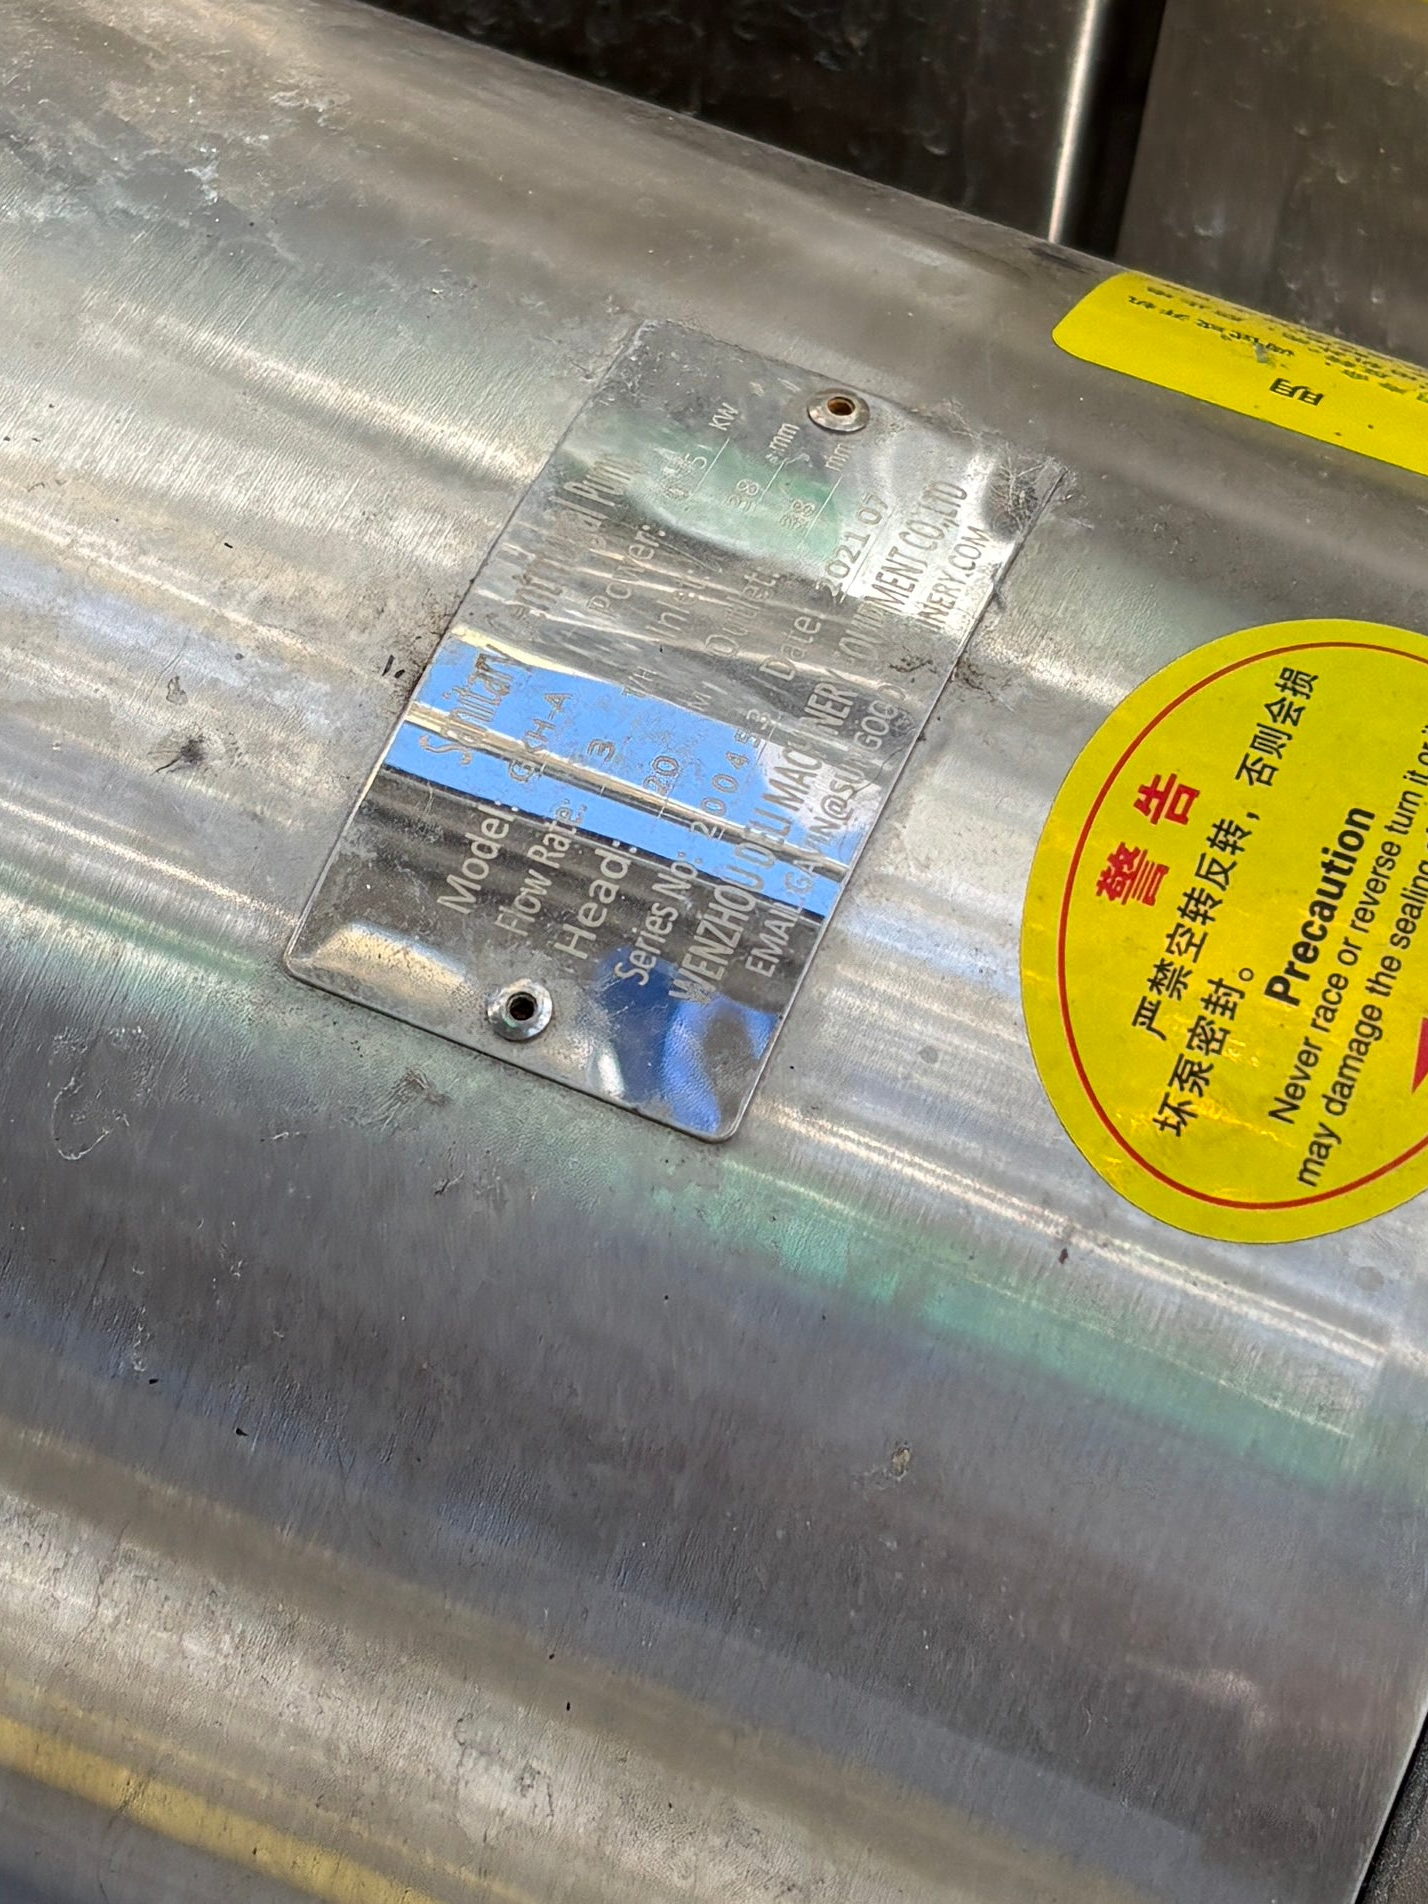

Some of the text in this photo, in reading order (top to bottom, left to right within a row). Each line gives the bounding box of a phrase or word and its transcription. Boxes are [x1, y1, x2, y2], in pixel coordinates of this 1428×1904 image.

[586, 402, 739, 614] Power: KW
[768, 421, 800, 453] mm
[419, 643, 528, 765] Sanitary
[436, 799, 519, 915] Model:
[495, 868, 552, 937] Flow
[586, 738, 616, 763] 3
[552, 839, 638, 960] Head:
[642, 753, 682, 795] 20
[667, 866, 764, 1006] WENZHOU
[762, 668, 859, 811] MACHNERY
[1096, 773, 1200, 907] 警告
[1264, 807, 1376, 1007] Precaution
[614, 901, 680, 986] Series
[1268, 1036, 1322, 1124] Never
[1310, 973, 1349, 1033] race
[1337, 936, 1362, 966] or
[1350, 841, 1402, 933] reverse
[1384, 790, 1423, 835] turn
[1297, 1122, 1342, 1187] may
[1321, 1004, 1383, 1116] damage
[1365, 955, 1402, 997] the
